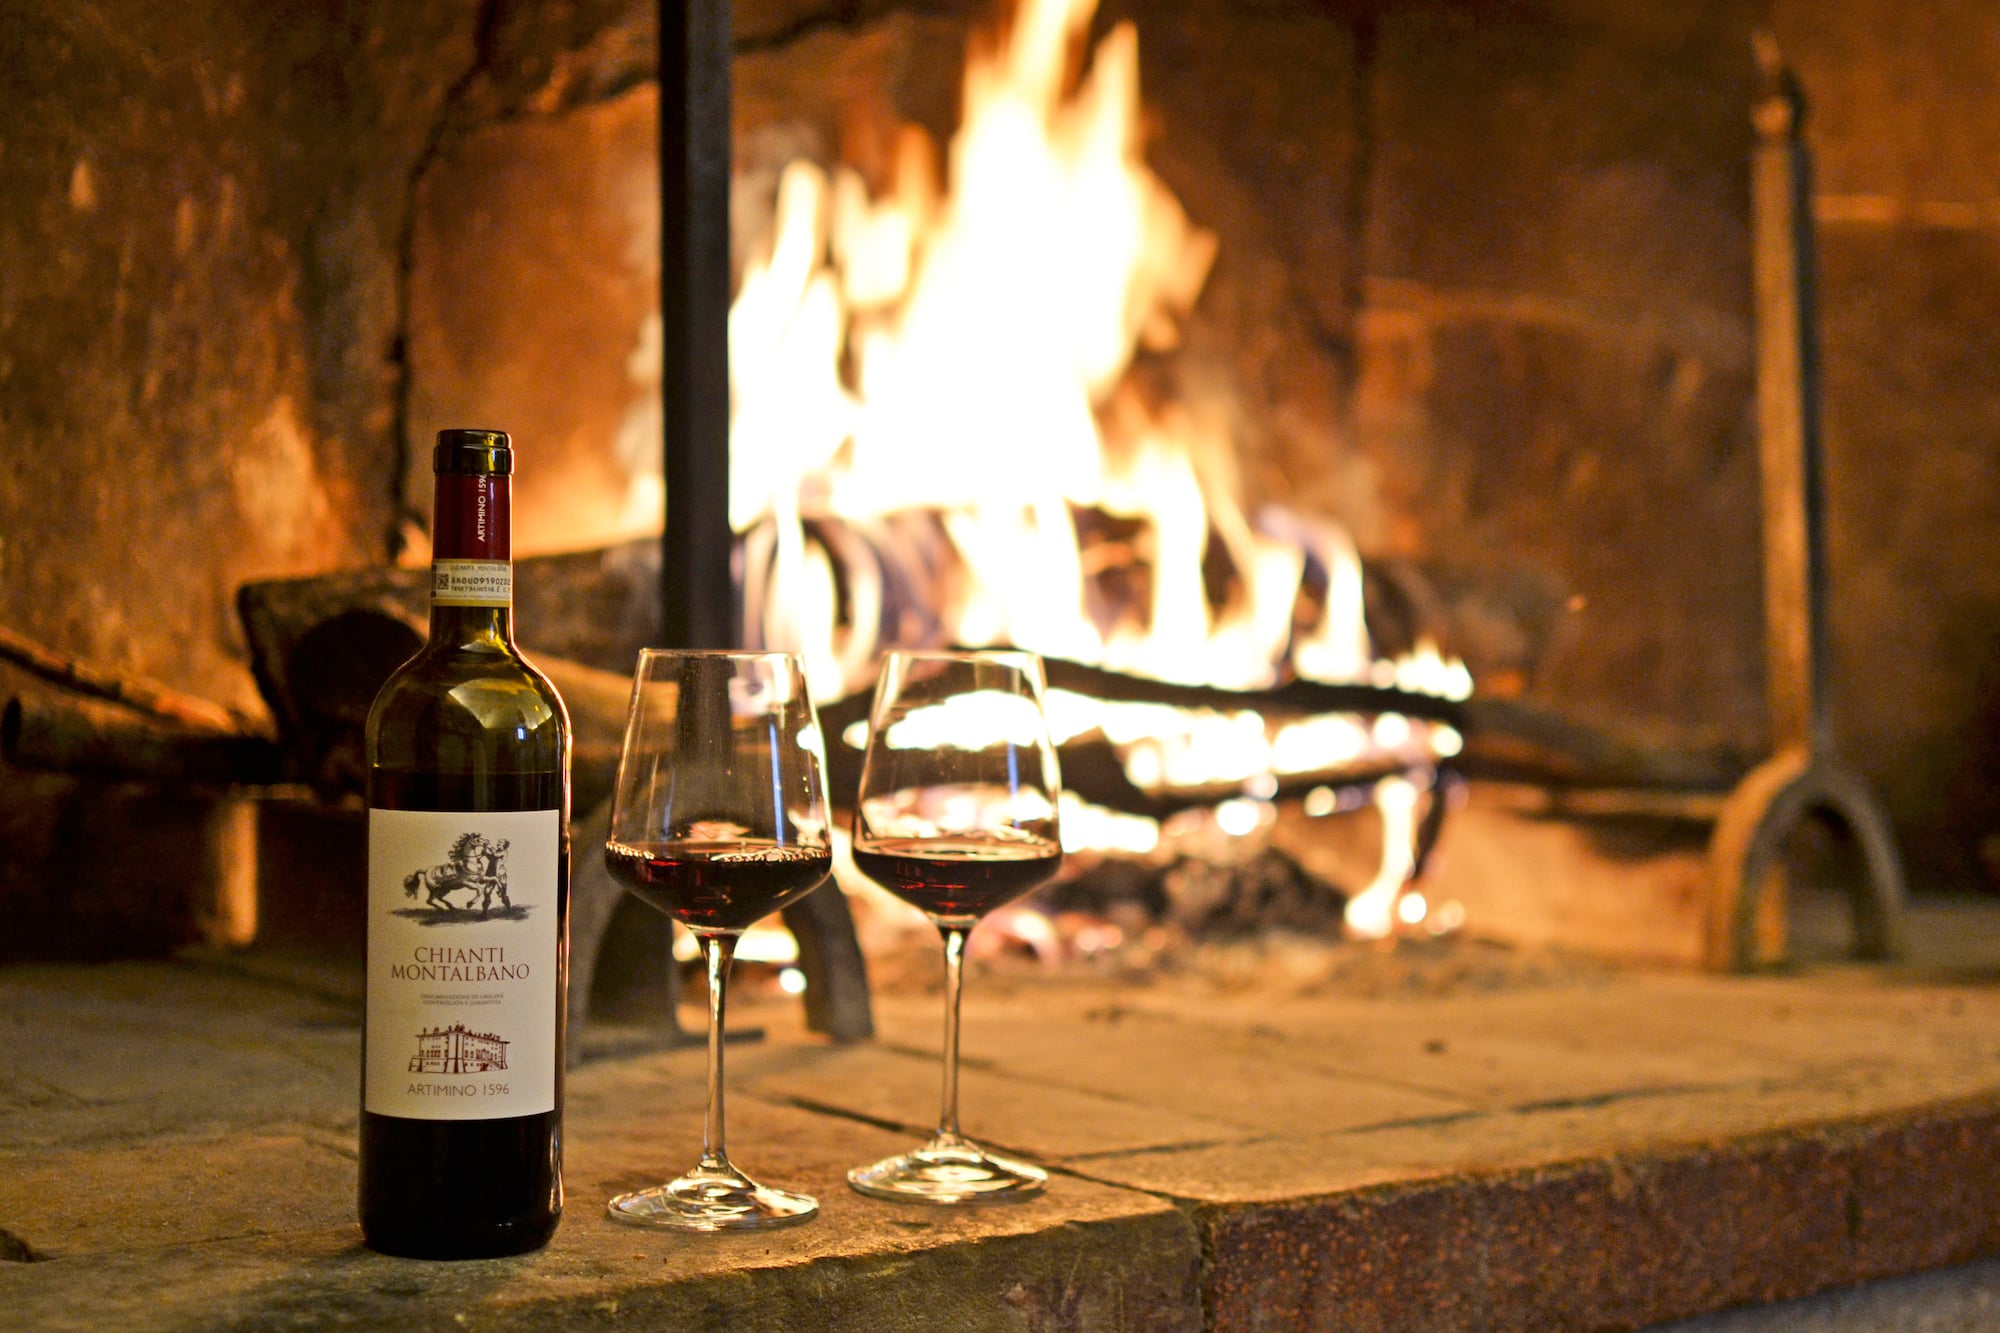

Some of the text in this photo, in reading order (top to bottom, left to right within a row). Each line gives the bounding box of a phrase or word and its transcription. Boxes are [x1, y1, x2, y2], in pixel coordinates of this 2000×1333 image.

[477, 495, 486, 543] ARTIMINO
[414, 946, 504, 964] CHIANTI
[390, 963, 530, 982] MONTALBANO
[407, 1083, 510, 1097] ARTIMINO 1596
